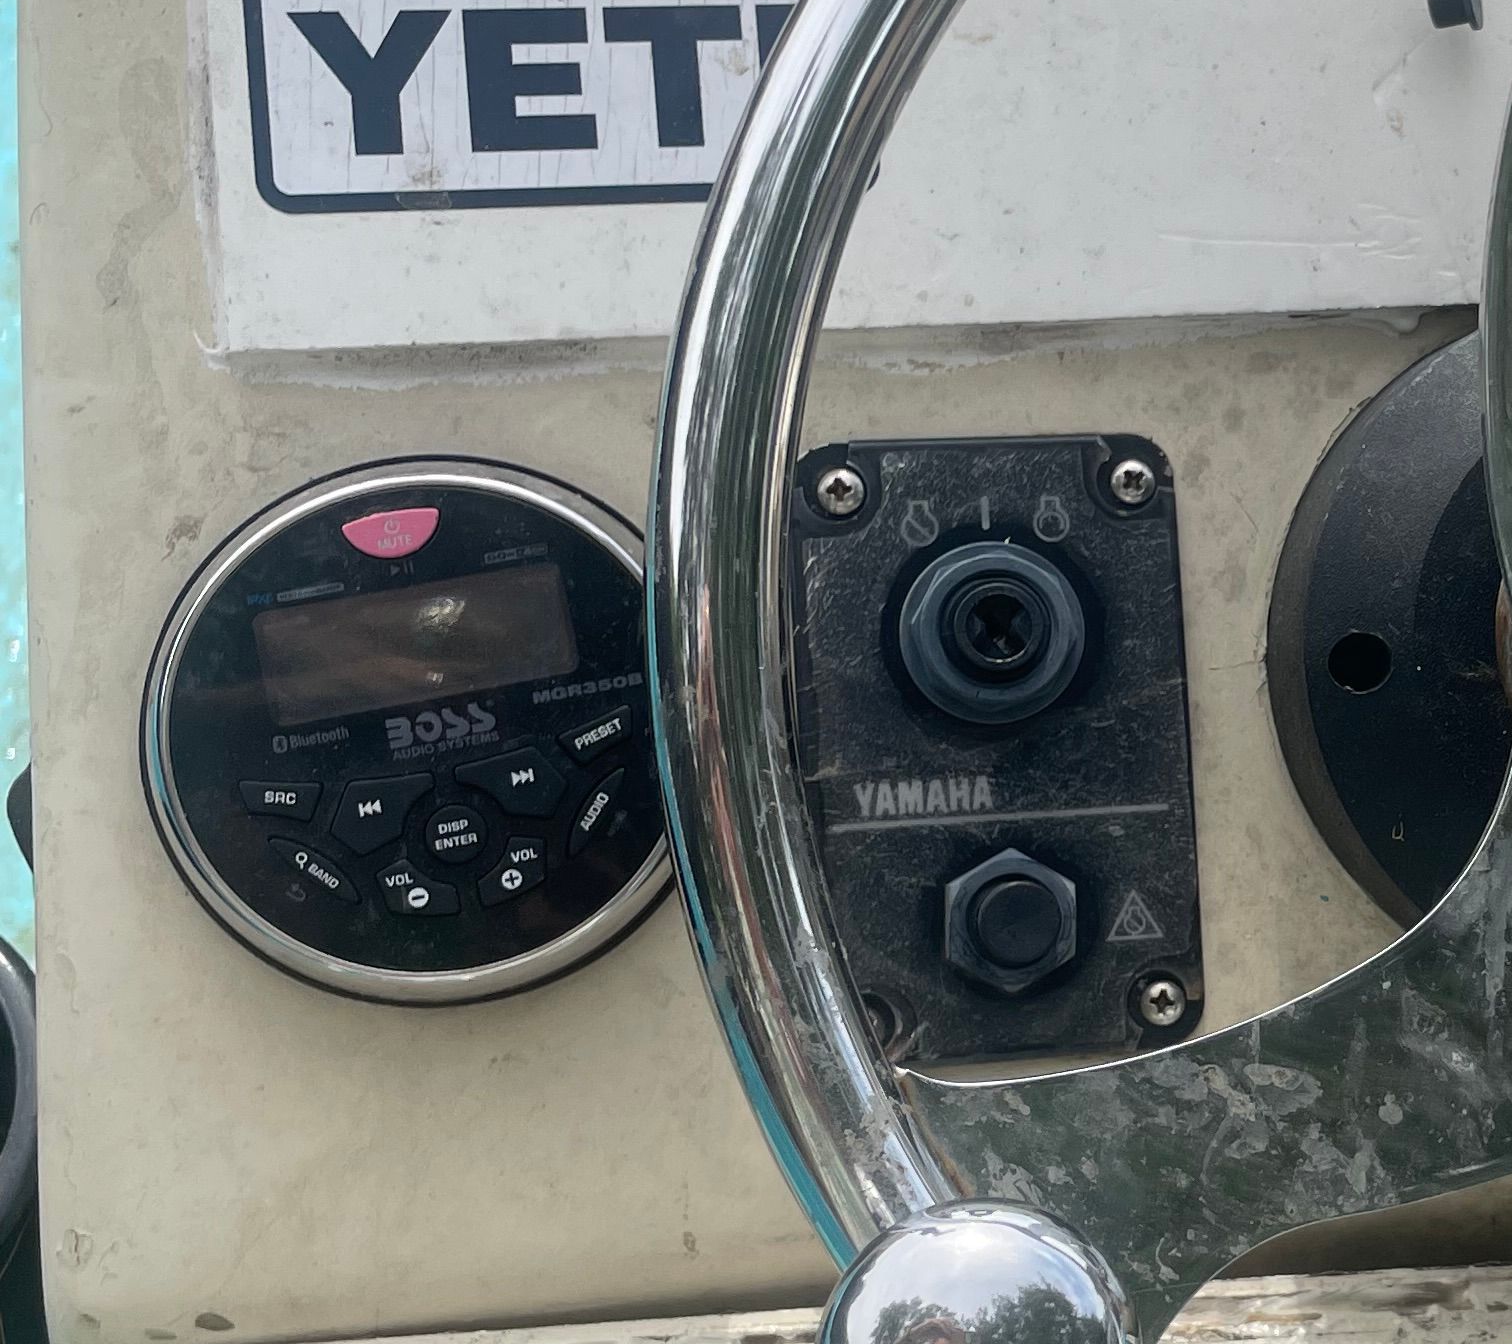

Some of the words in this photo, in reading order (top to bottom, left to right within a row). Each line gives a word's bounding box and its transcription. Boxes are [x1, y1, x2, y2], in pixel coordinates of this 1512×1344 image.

[286, 4, 796, 156] YET
[377, 533, 412, 550] MUTE
[288, 724, 350, 750] Bluetooth
[384, 701, 496, 750] BOSS
[574, 717, 622, 751] PRESET
[393, 742, 434, 761] AUDIO
[437, 731, 499, 755] SYSTEMS
[264, 790, 296, 805] SRC
[854, 775, 997, 818] YAMAHA
[579, 791, 610, 832] AUDIO
[438, 818, 469, 836] DISP
[435, 832, 479, 851] ENTER
[510, 845, 537, 863] VOL
[307, 862, 339, 891] BAND
[385, 871, 413, 887] VOL
